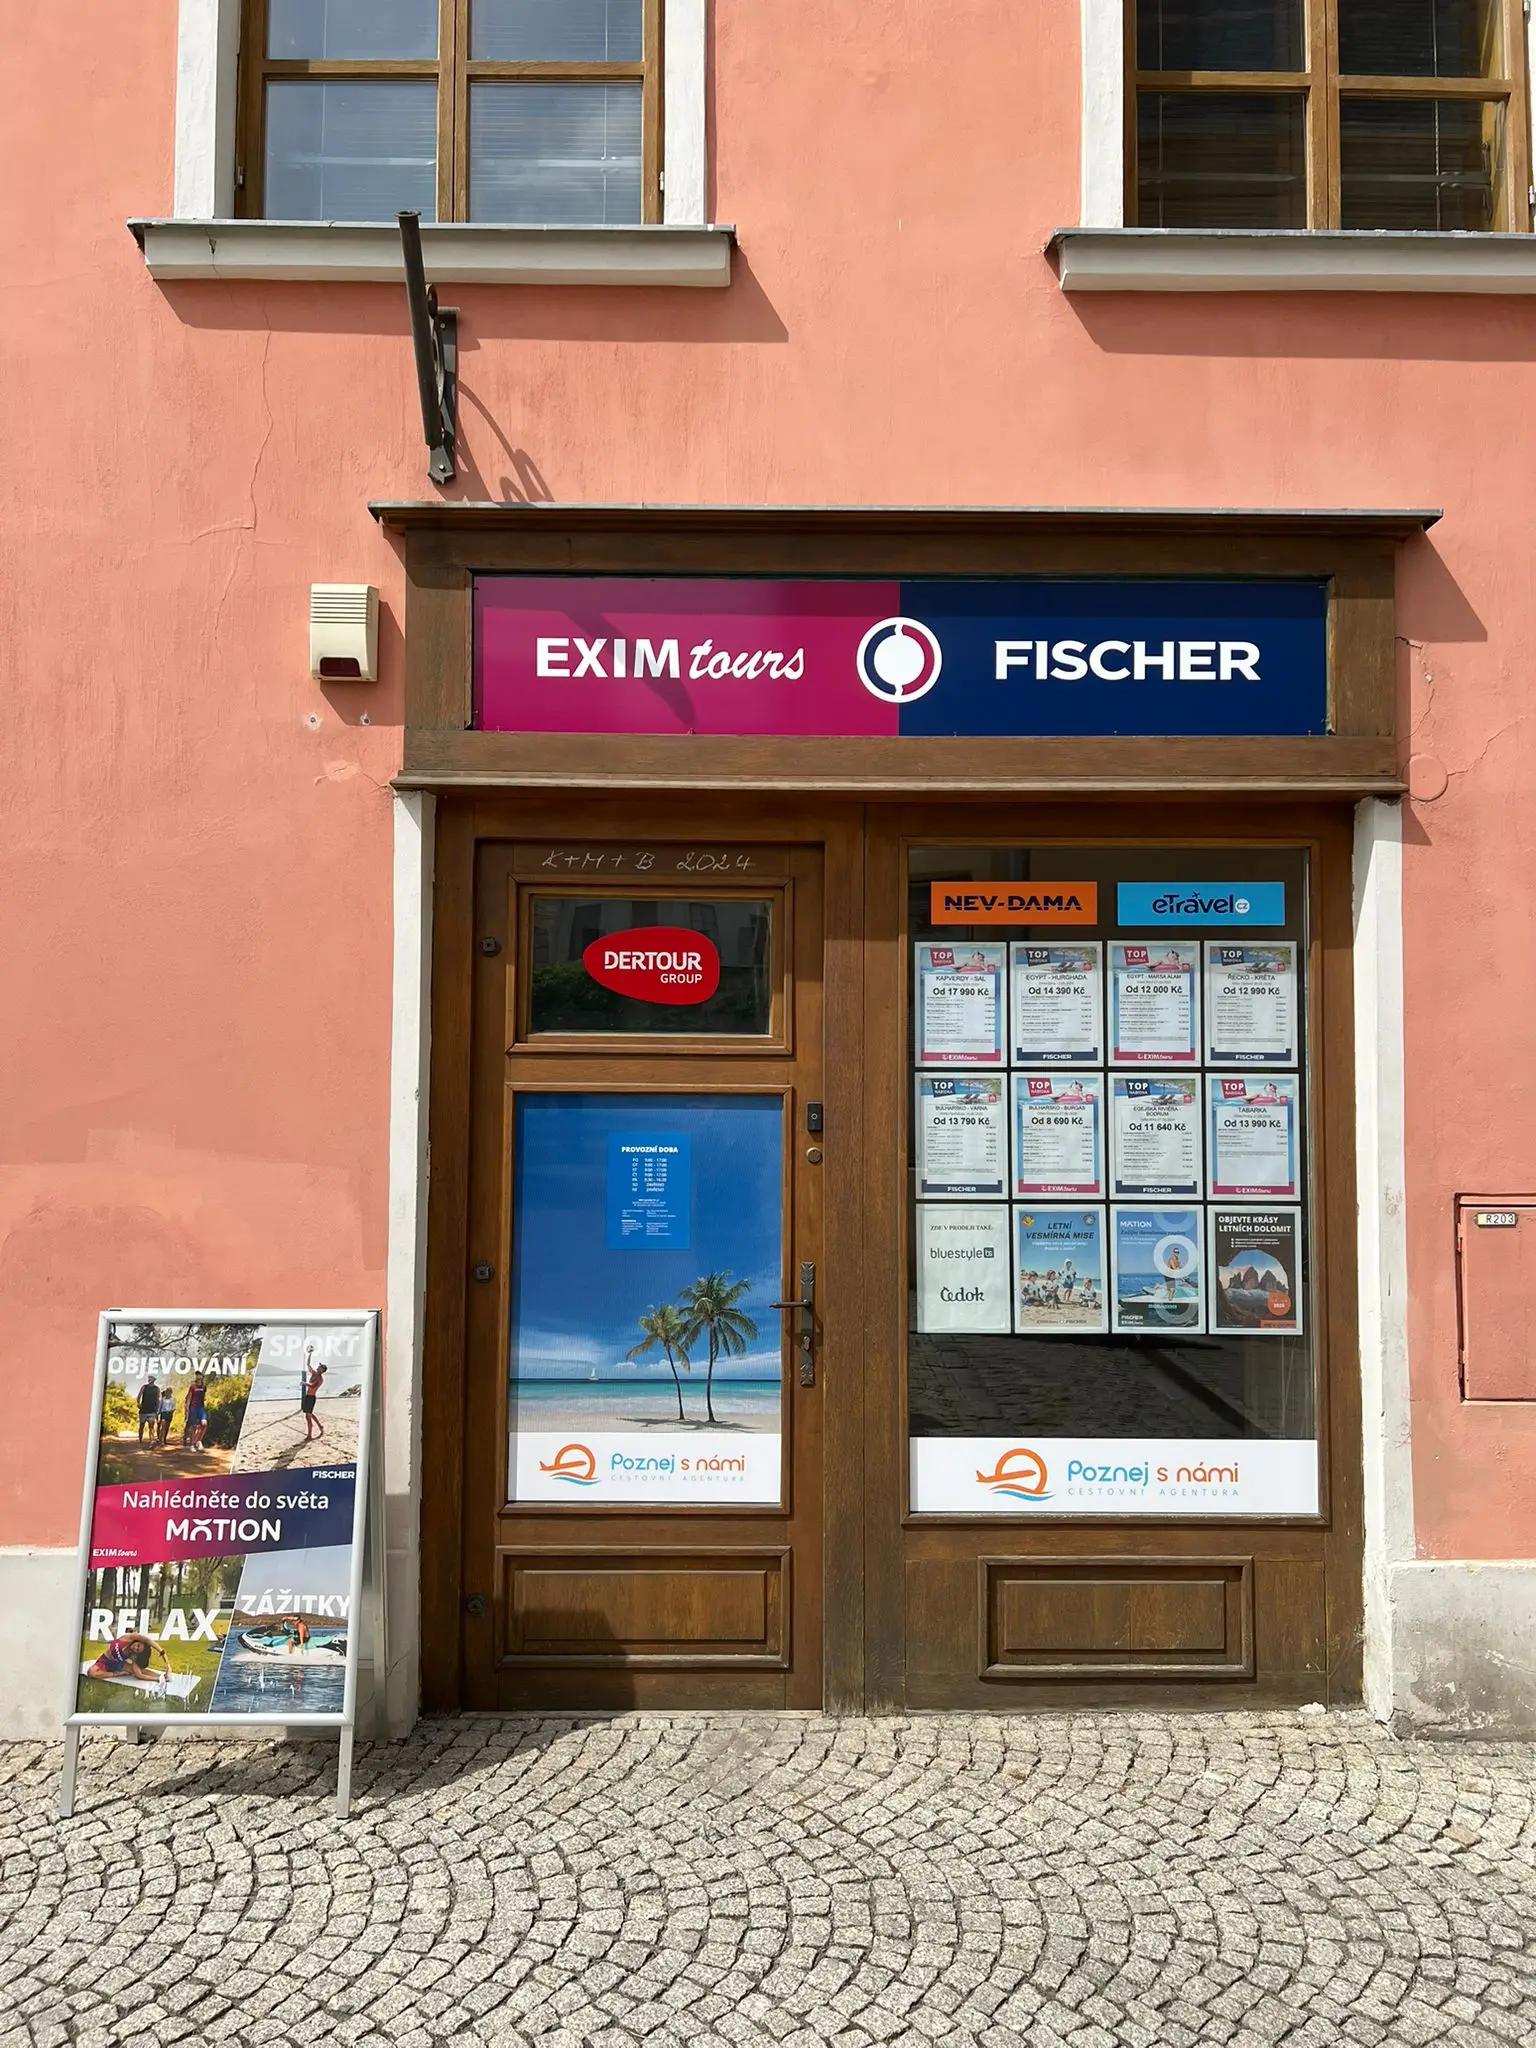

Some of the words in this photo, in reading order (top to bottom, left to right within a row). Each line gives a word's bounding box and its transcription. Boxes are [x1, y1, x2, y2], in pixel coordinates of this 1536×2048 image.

[536, 638, 680, 678] EXIM
[689, 638, 804, 680] tours
[994, 640, 1261, 681] FISCHER
[944, 894, 1082, 911] NEV-DAMA
[604, 950, 702, 971] DERTOUR
[660, 974, 702, 984] GROUP
[1048, 1221, 1072, 1229] LETNÍ
[1219, 1216, 1251, 1224] OBJEVTE
[1486, 1214, 1514, 1224] R203
[930, 1248, 982, 1260] bluestyle
[940, 1287, 984, 1302] Čedok
[269, 1334, 360, 1357] SPORT
[108, 1353, 247, 1379] OBJEVOVÁNÍ
[610, 1452, 676, 1473] Poznej
[680, 1458, 690, 1470] s
[696, 1454, 745, 1472] námi
[312, 1470, 355, 1479] FISCHER
[1068, 1460, 1150, 1486] Poznej
[1156, 1466, 1168, 1482] s
[1176, 1462, 1239, 1483] námi
[123, 1491, 240, 1509] Nahlédněte
[245, 1491, 271, 1509] do
[276, 1492, 329, 1510] světa
[1159, 1488, 1239, 1496] AGENTURA
[241, 1588, 350, 1617] ZÁŽITKY
[89, 1608, 221, 1642] RELAX
